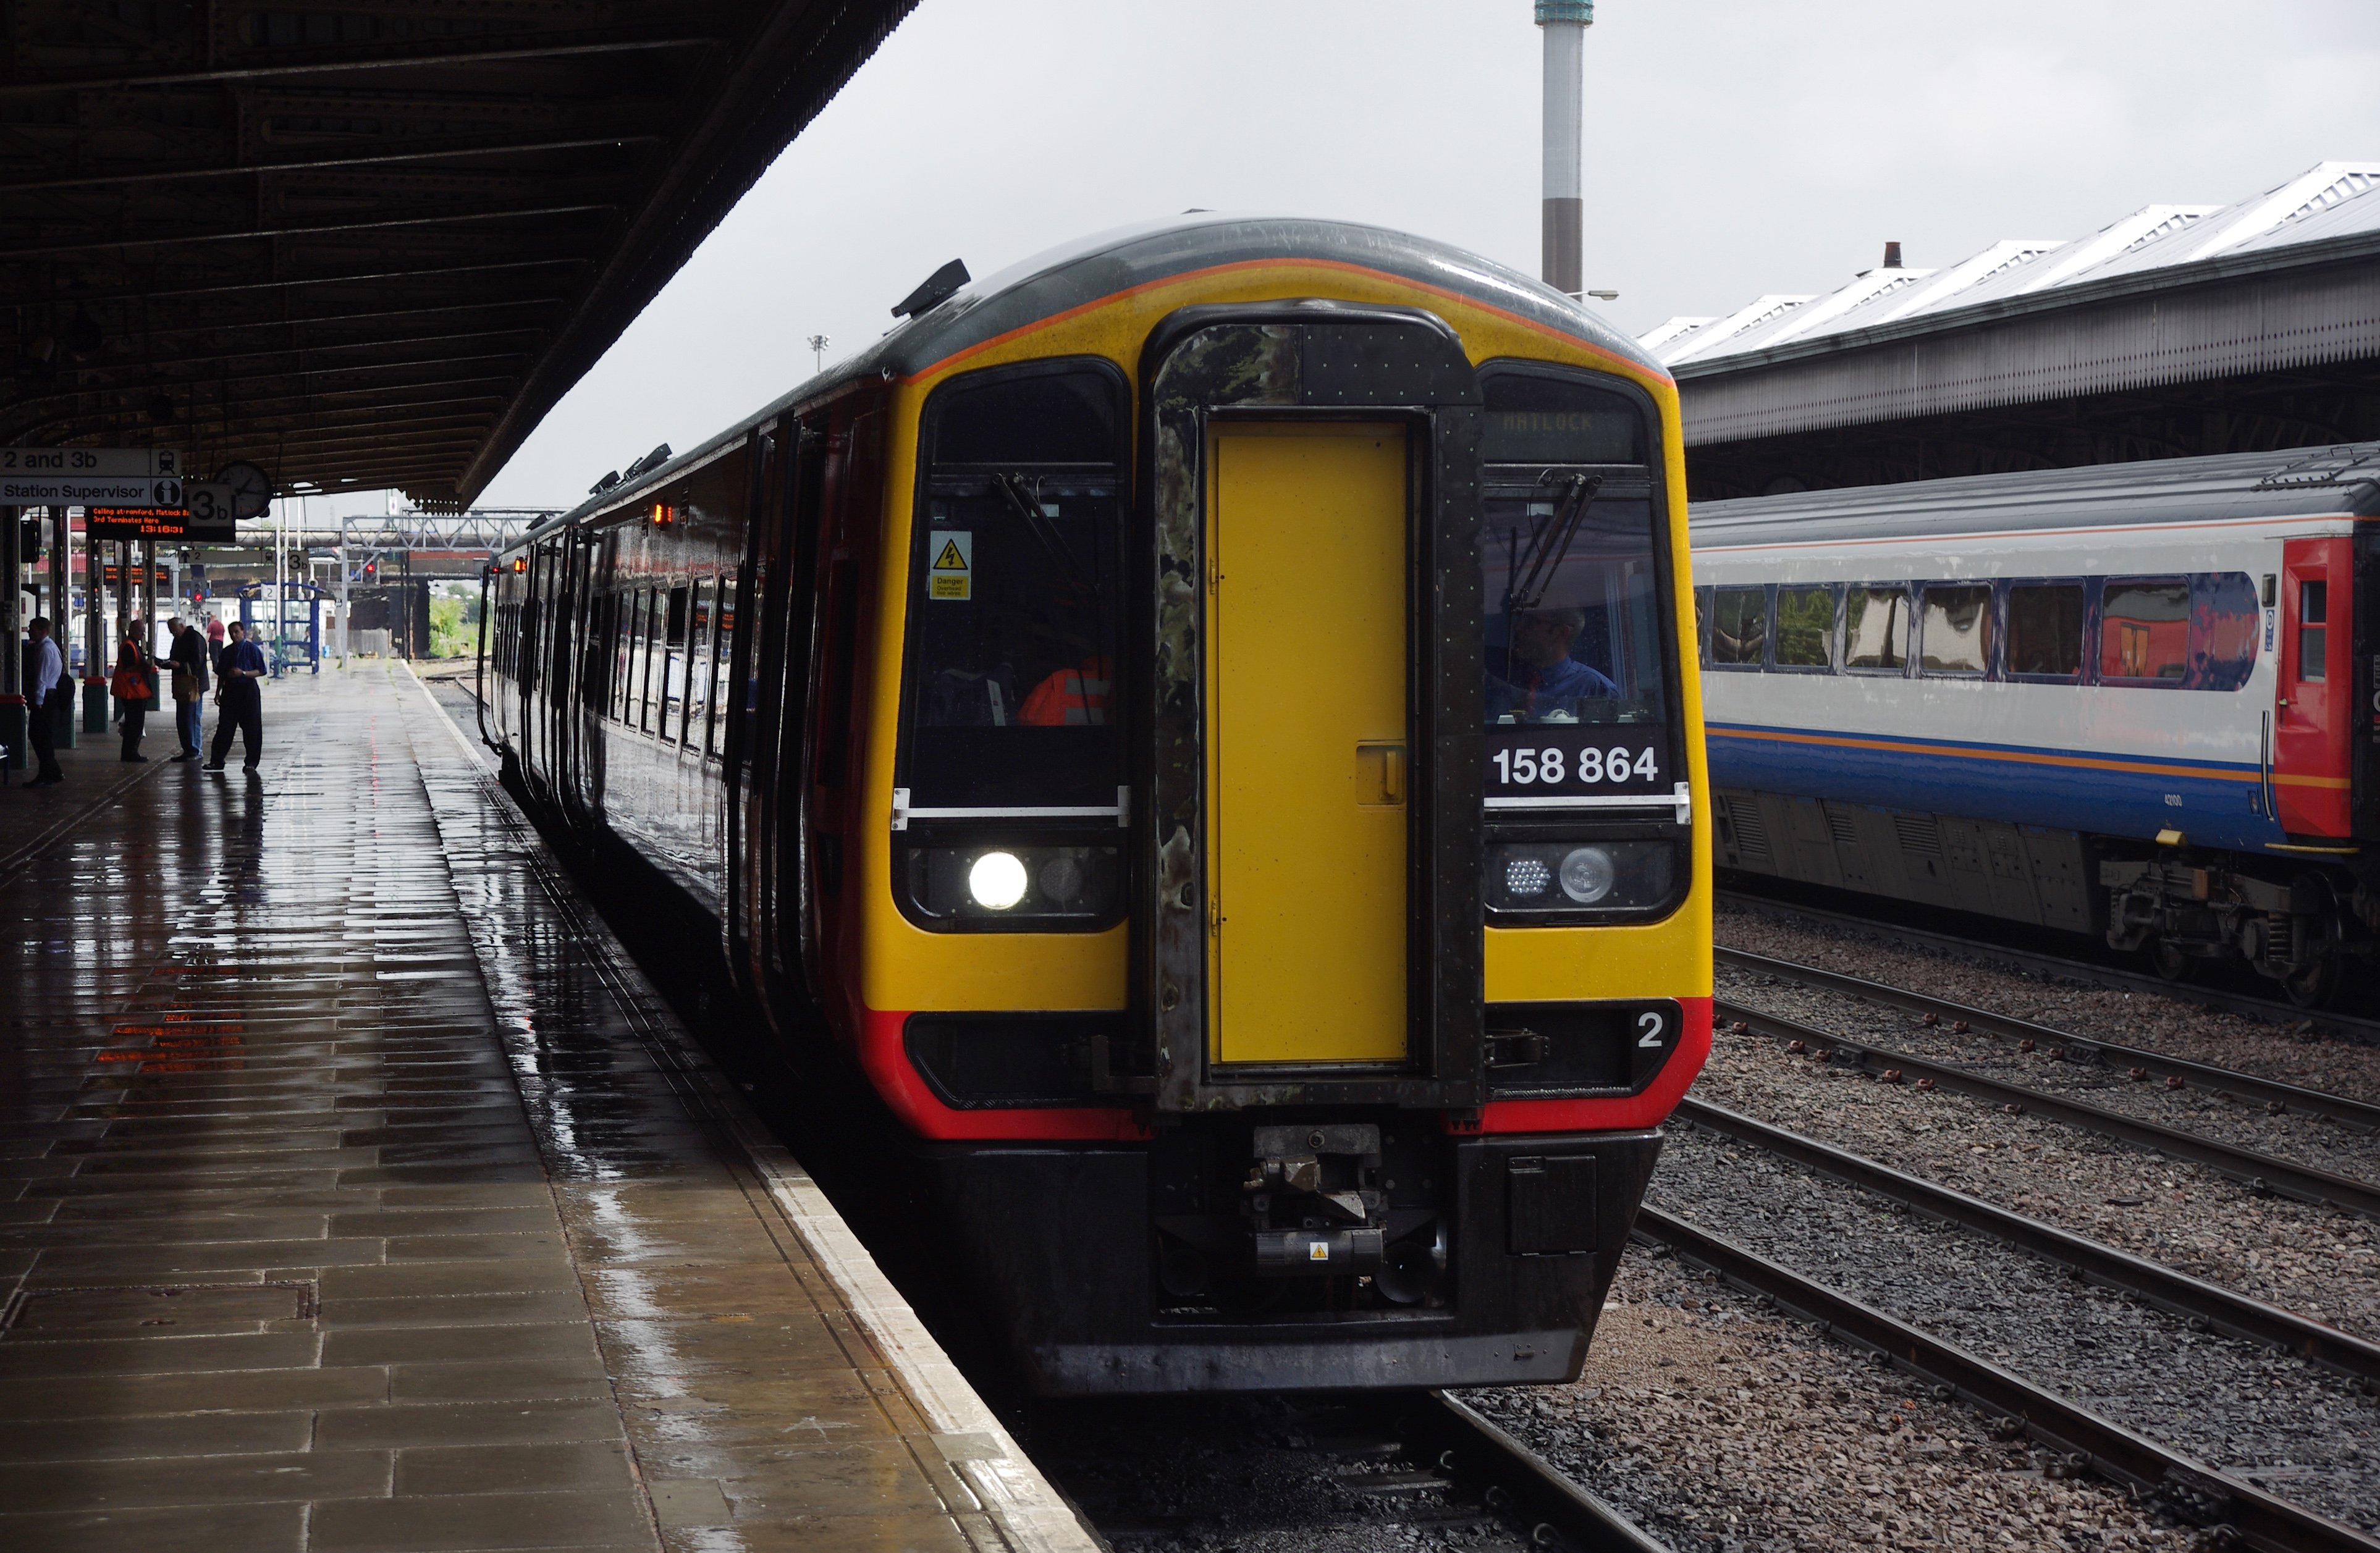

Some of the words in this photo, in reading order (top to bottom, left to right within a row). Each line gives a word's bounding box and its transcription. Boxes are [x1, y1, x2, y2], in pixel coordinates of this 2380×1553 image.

[1503, 411, 1593, 431] MATLOCK
[4, 451, 17, 468] 2
[25, 451, 62, 468] and
[71, 451, 97, 468] 3b
[4, 484, 58, 497] Station
[62, 484, 144, 500] Supervisor
[93, 507, 114, 515] Calling
[156, 508, 180, 516] Matlock
[192, 490, 228, 520] 3b
[107, 516, 142, 524] Terminates
[195, 552, 201, 560] 2
[289, 555, 308, 570] 3b
[937, 578, 963, 586] Danger
[267, 588, 273, 597] 2
[1492, 747, 1566, 784] 158
[1578, 746, 1658, 783] 864
[2164, 793, 2182, 807] 42100
[1637, 1011, 1663, 1048] 2
